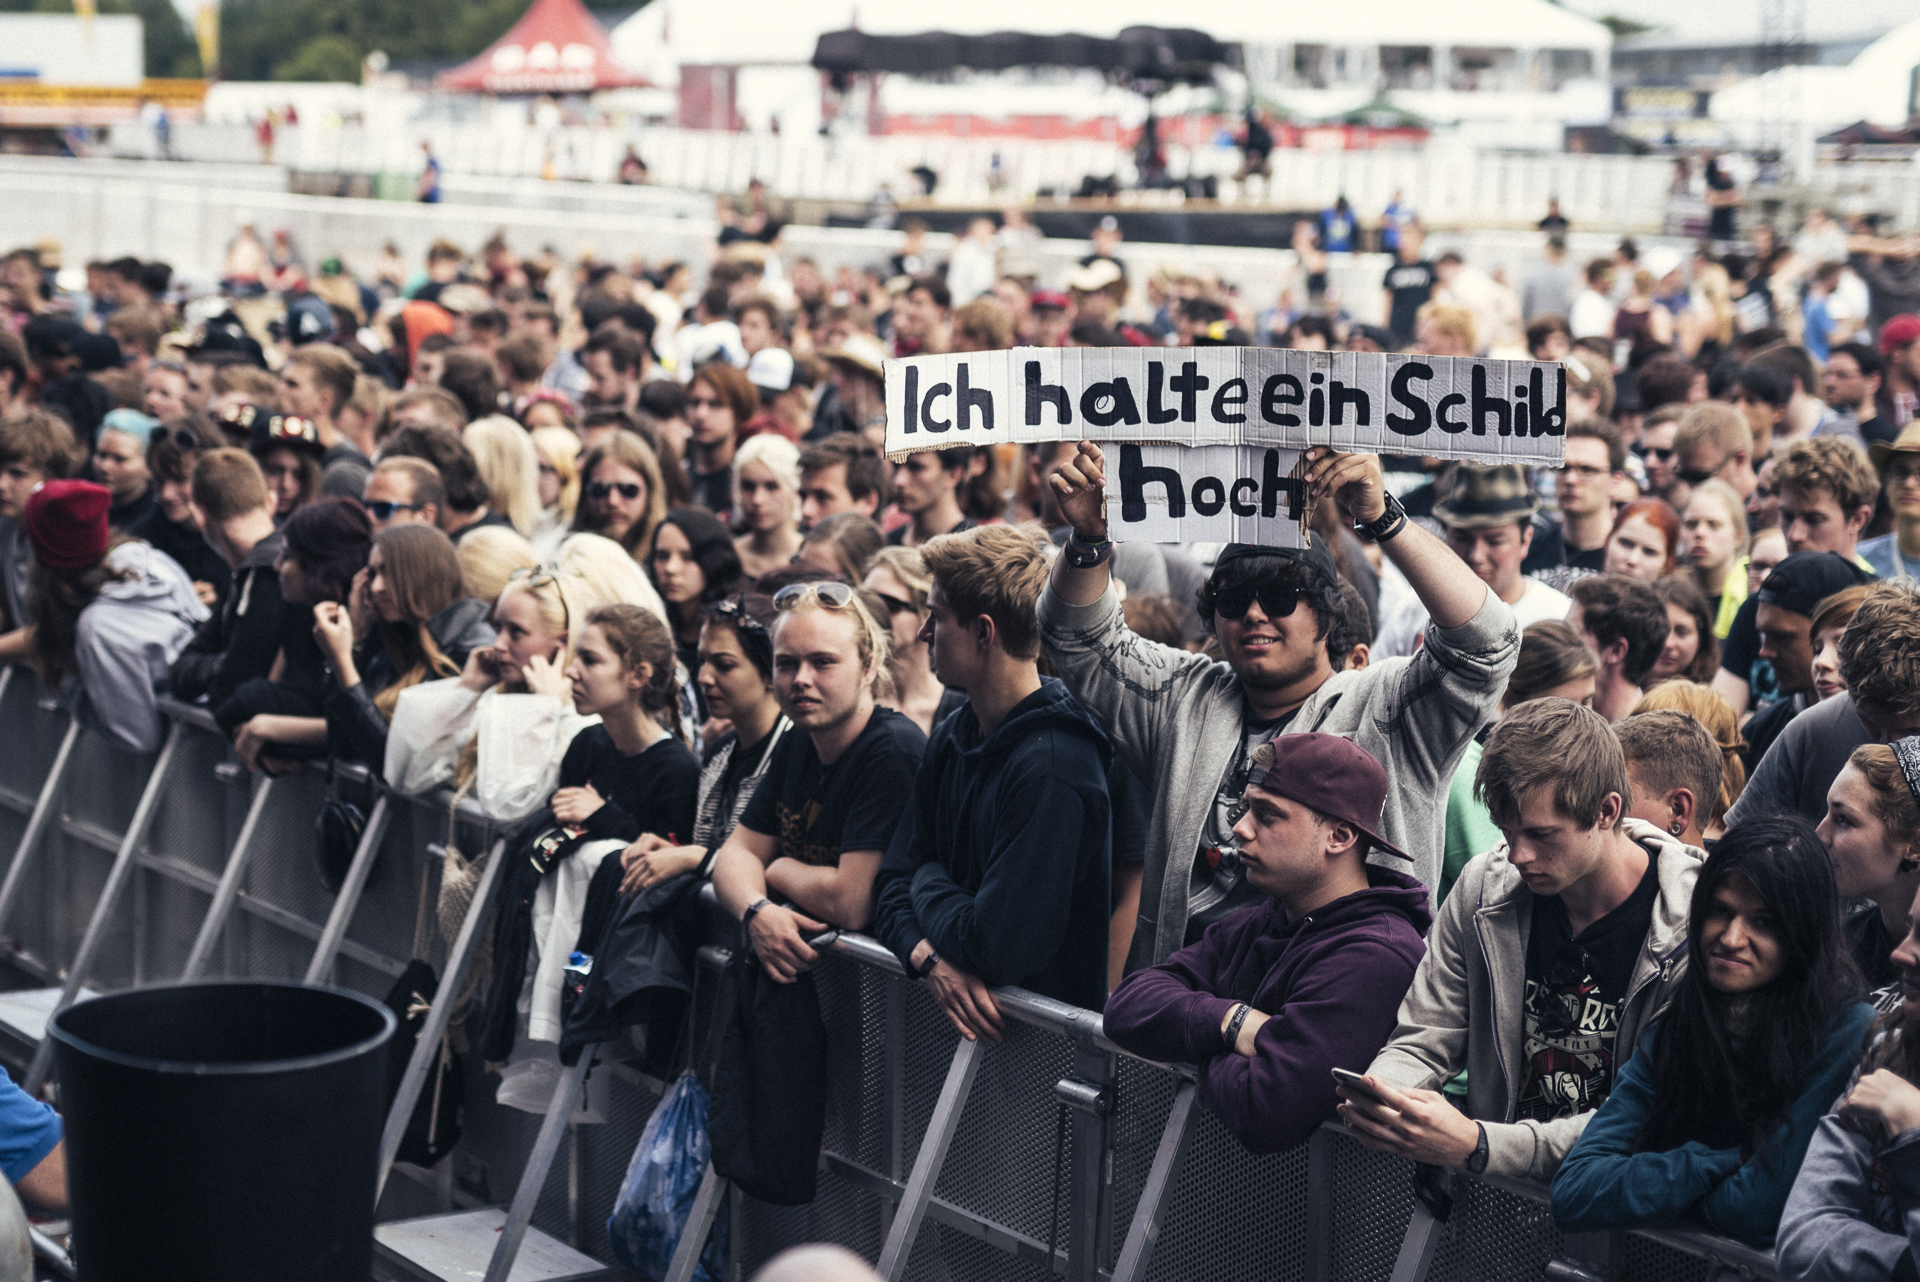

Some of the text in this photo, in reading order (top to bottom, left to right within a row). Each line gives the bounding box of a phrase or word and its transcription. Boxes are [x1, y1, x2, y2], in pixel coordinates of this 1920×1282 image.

[904, 360, 1566, 438] Ich halte ein Schild
[1119, 444, 1304, 523] hoch
